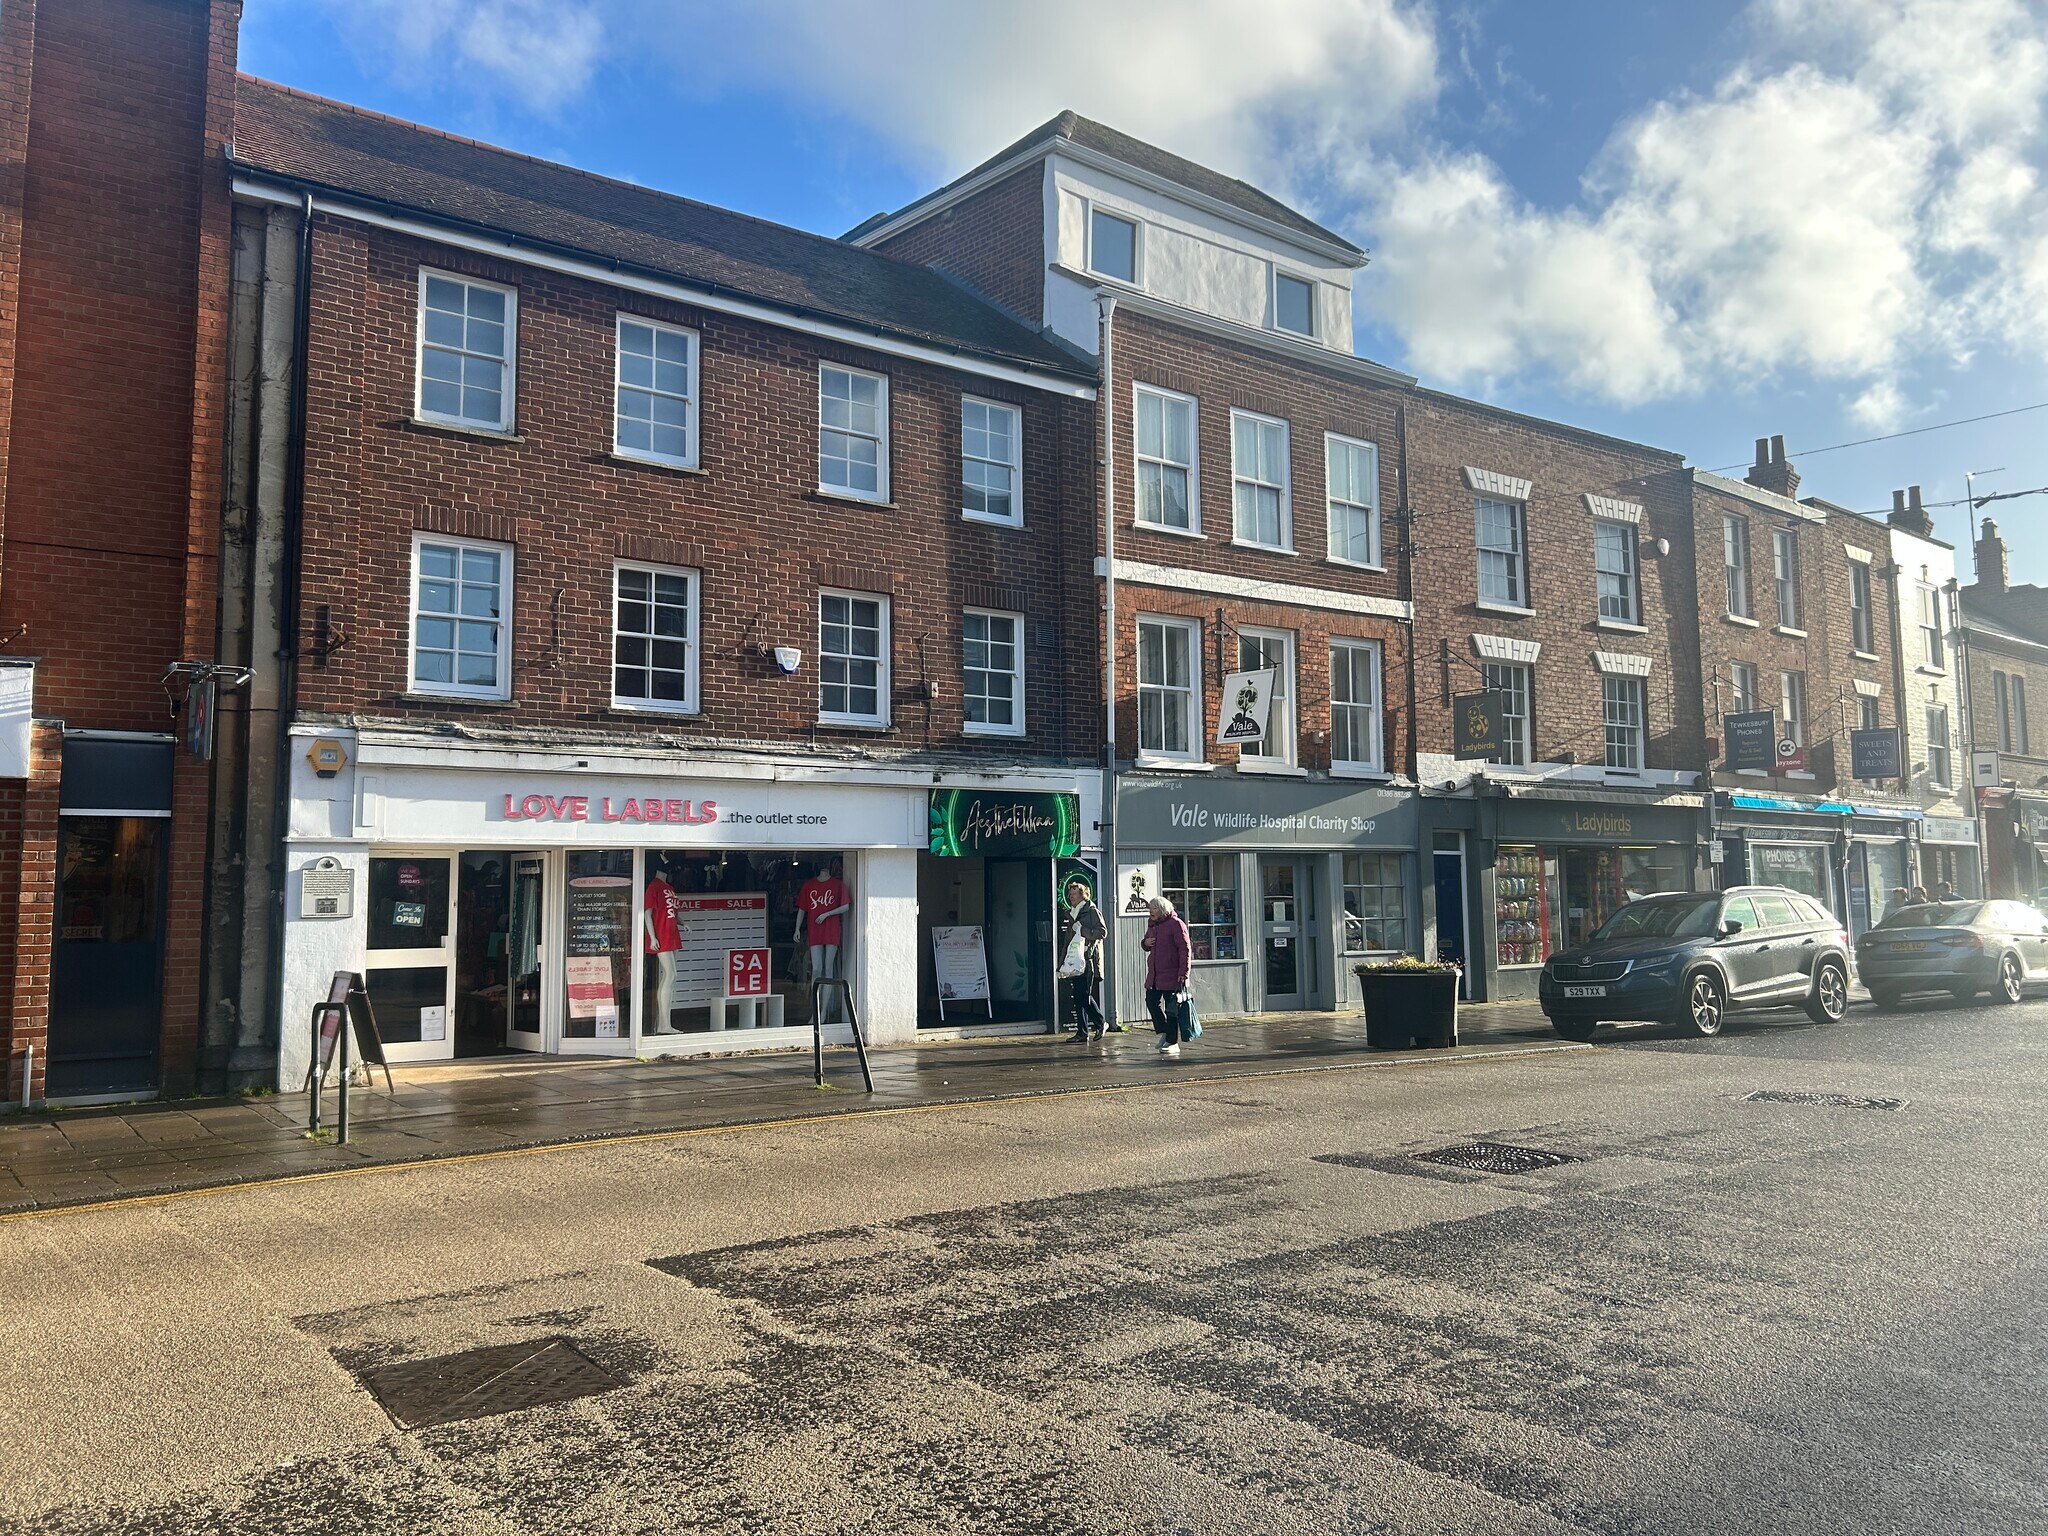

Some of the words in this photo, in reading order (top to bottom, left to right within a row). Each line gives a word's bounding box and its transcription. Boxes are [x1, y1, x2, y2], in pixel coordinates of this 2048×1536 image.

[1232, 720, 1253, 732] Vale
[1729, 720, 1770, 728] TEWKESBURY
[1462, 742, 1496, 752] Ladybirds
[504, 794, 588, 818] LOVE
[602, 796, 718, 823] LABELS
[756, 812, 793, 824] outlet
[796, 813, 828, 824] store
[1170, 804, 1208, 827] Vale
[1214, 813, 1256, 828] Wildlife
[1260, 814, 1306, 832] Hospital
[1309, 816, 1348, 832] Charity
[1351, 816, 1376, 834] Shop
[1576, 812, 1632, 836] Ladybirds
[1766, 850, 1796, 862] PHONES
[727, 900, 752, 908] SALE
[809, 889, 835, 910] Sale
[398, 904, 413, 912] Come
[1131, 900, 1146, 910] Vale
[396, 916, 420, 924] OPEN
[66, 928, 99, 937] SECRET
[1570, 988, 1583, 996] S29
[1585, 987, 1600, 995] TXX
